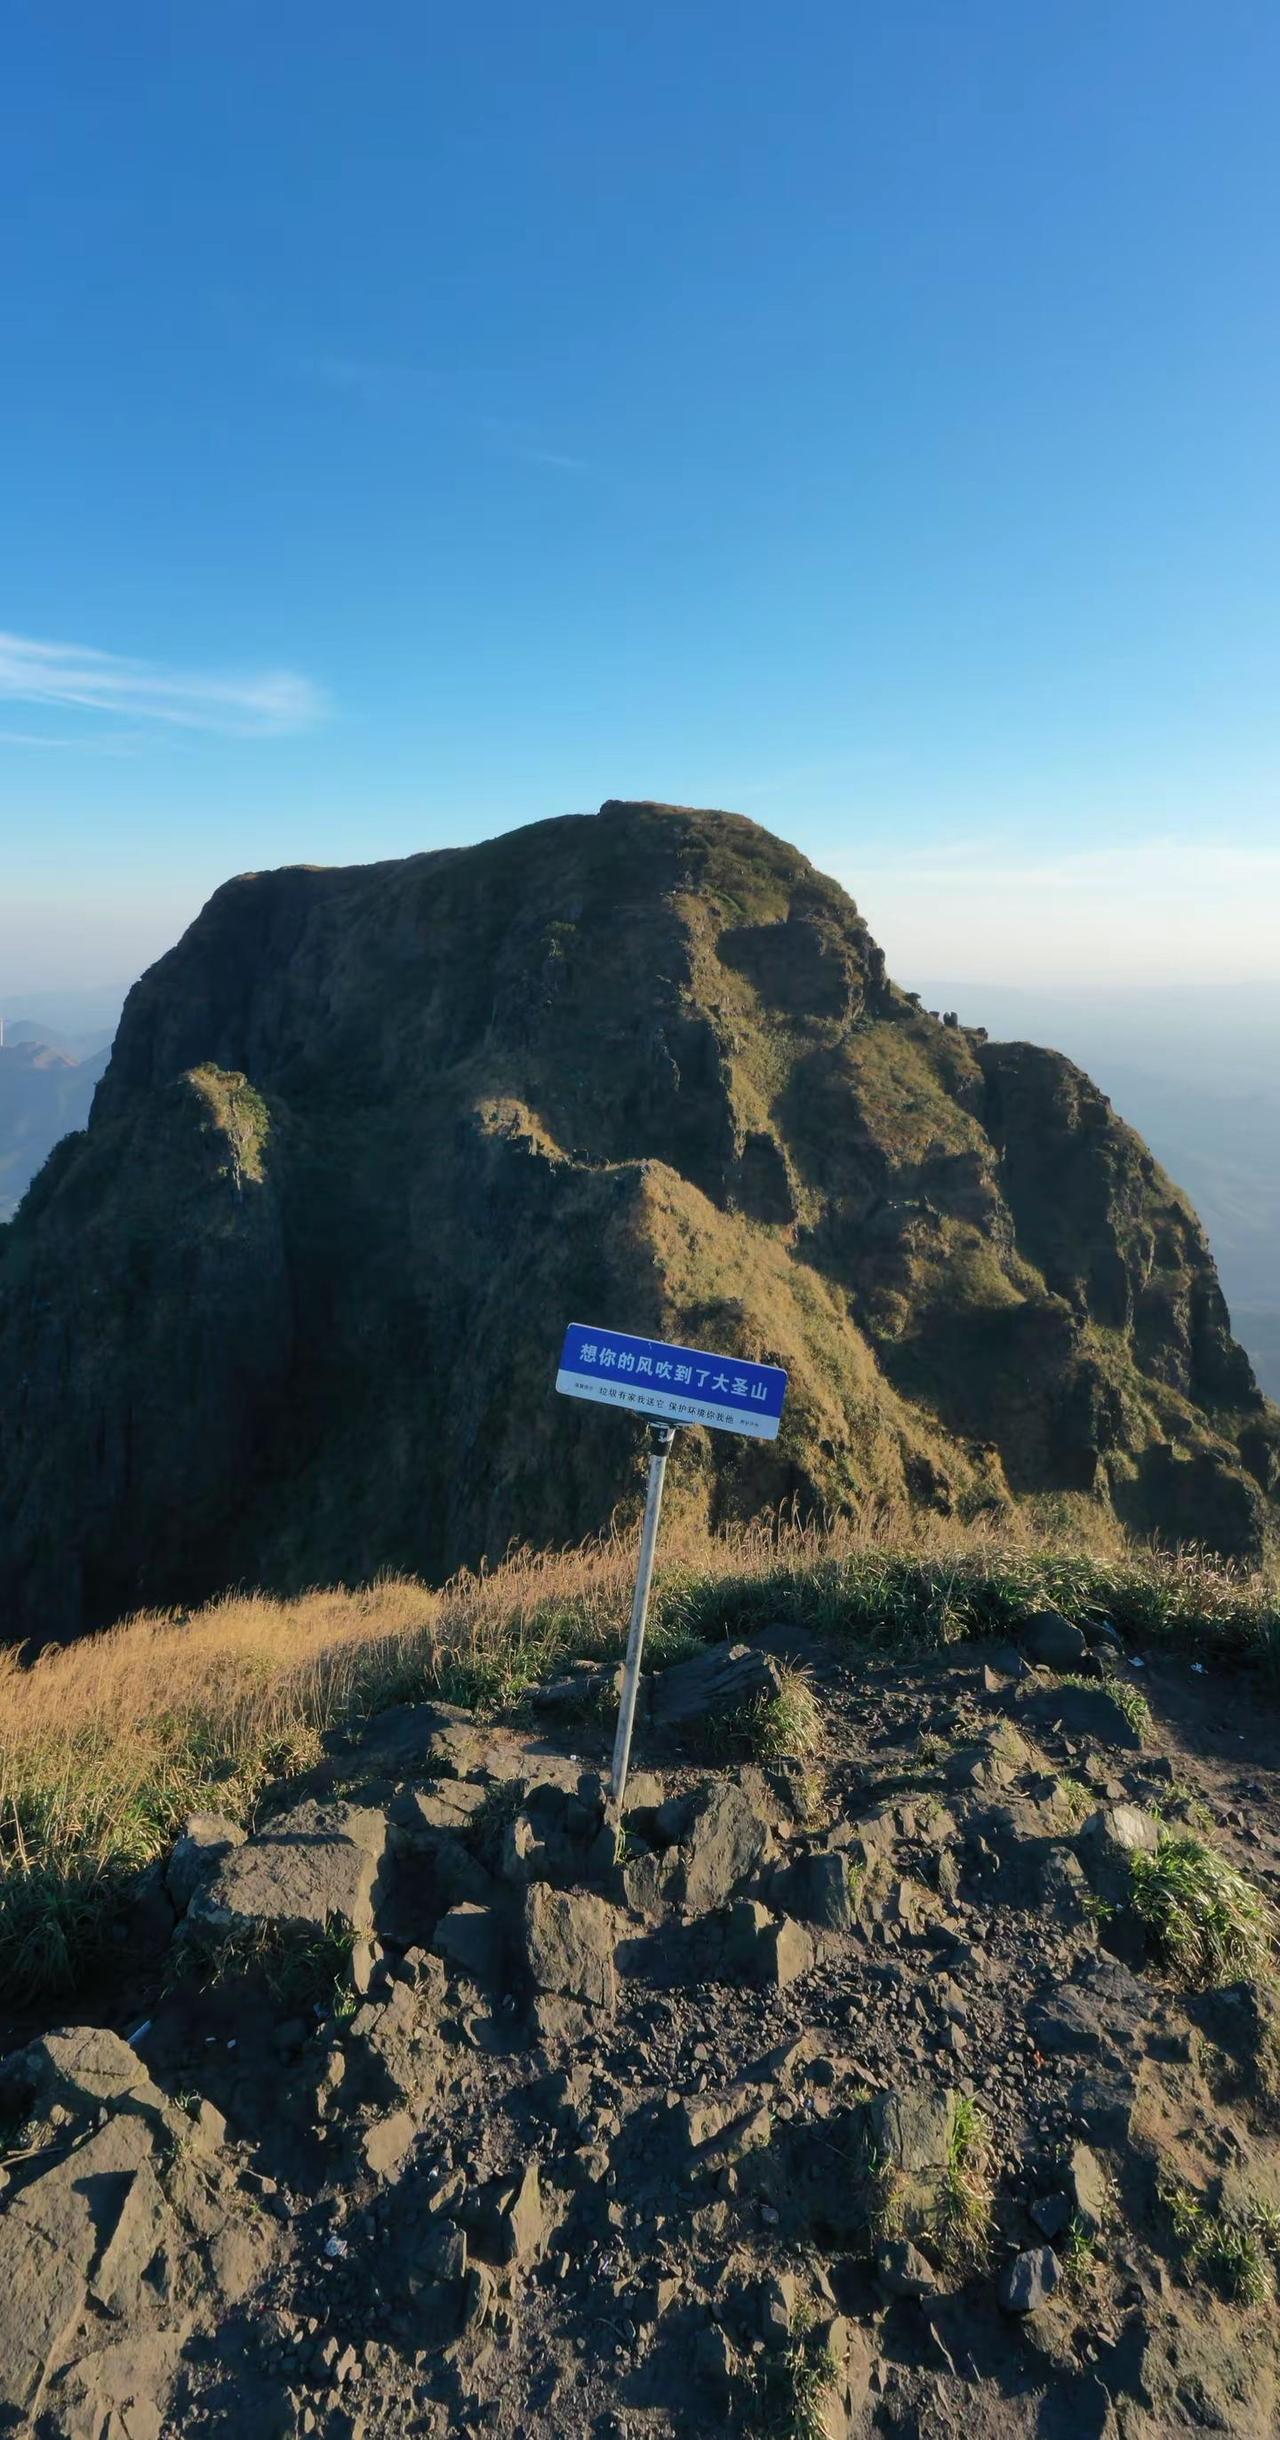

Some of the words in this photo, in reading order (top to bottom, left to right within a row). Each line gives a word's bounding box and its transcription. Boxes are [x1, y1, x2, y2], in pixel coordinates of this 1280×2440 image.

[579, 1343, 768, 1401] 想你的风吹到了大圣山
